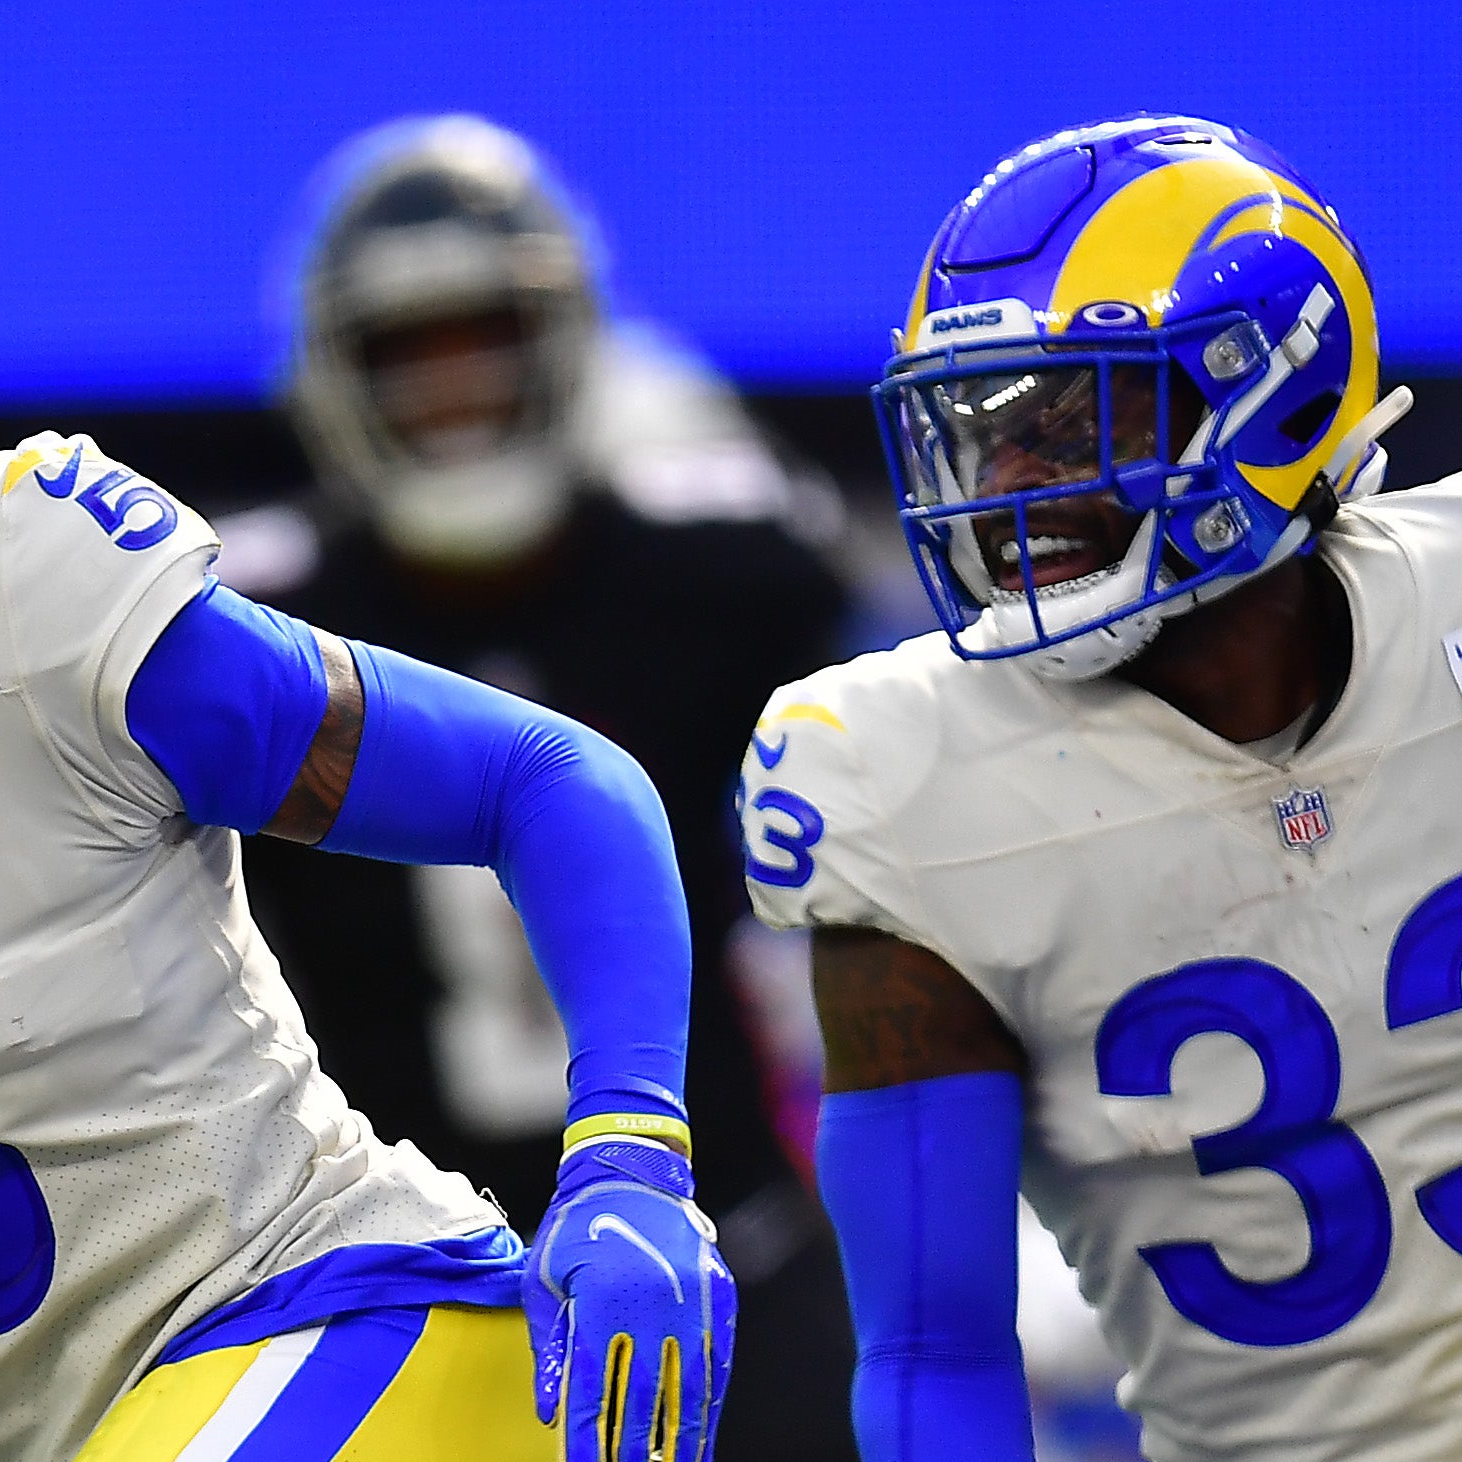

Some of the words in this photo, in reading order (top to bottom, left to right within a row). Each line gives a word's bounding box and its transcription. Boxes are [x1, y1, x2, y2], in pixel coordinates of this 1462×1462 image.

[931, 309, 1002, 334] RAMS
[75, 469, 177, 551] 5
[1286, 811, 1327, 840] NFL
